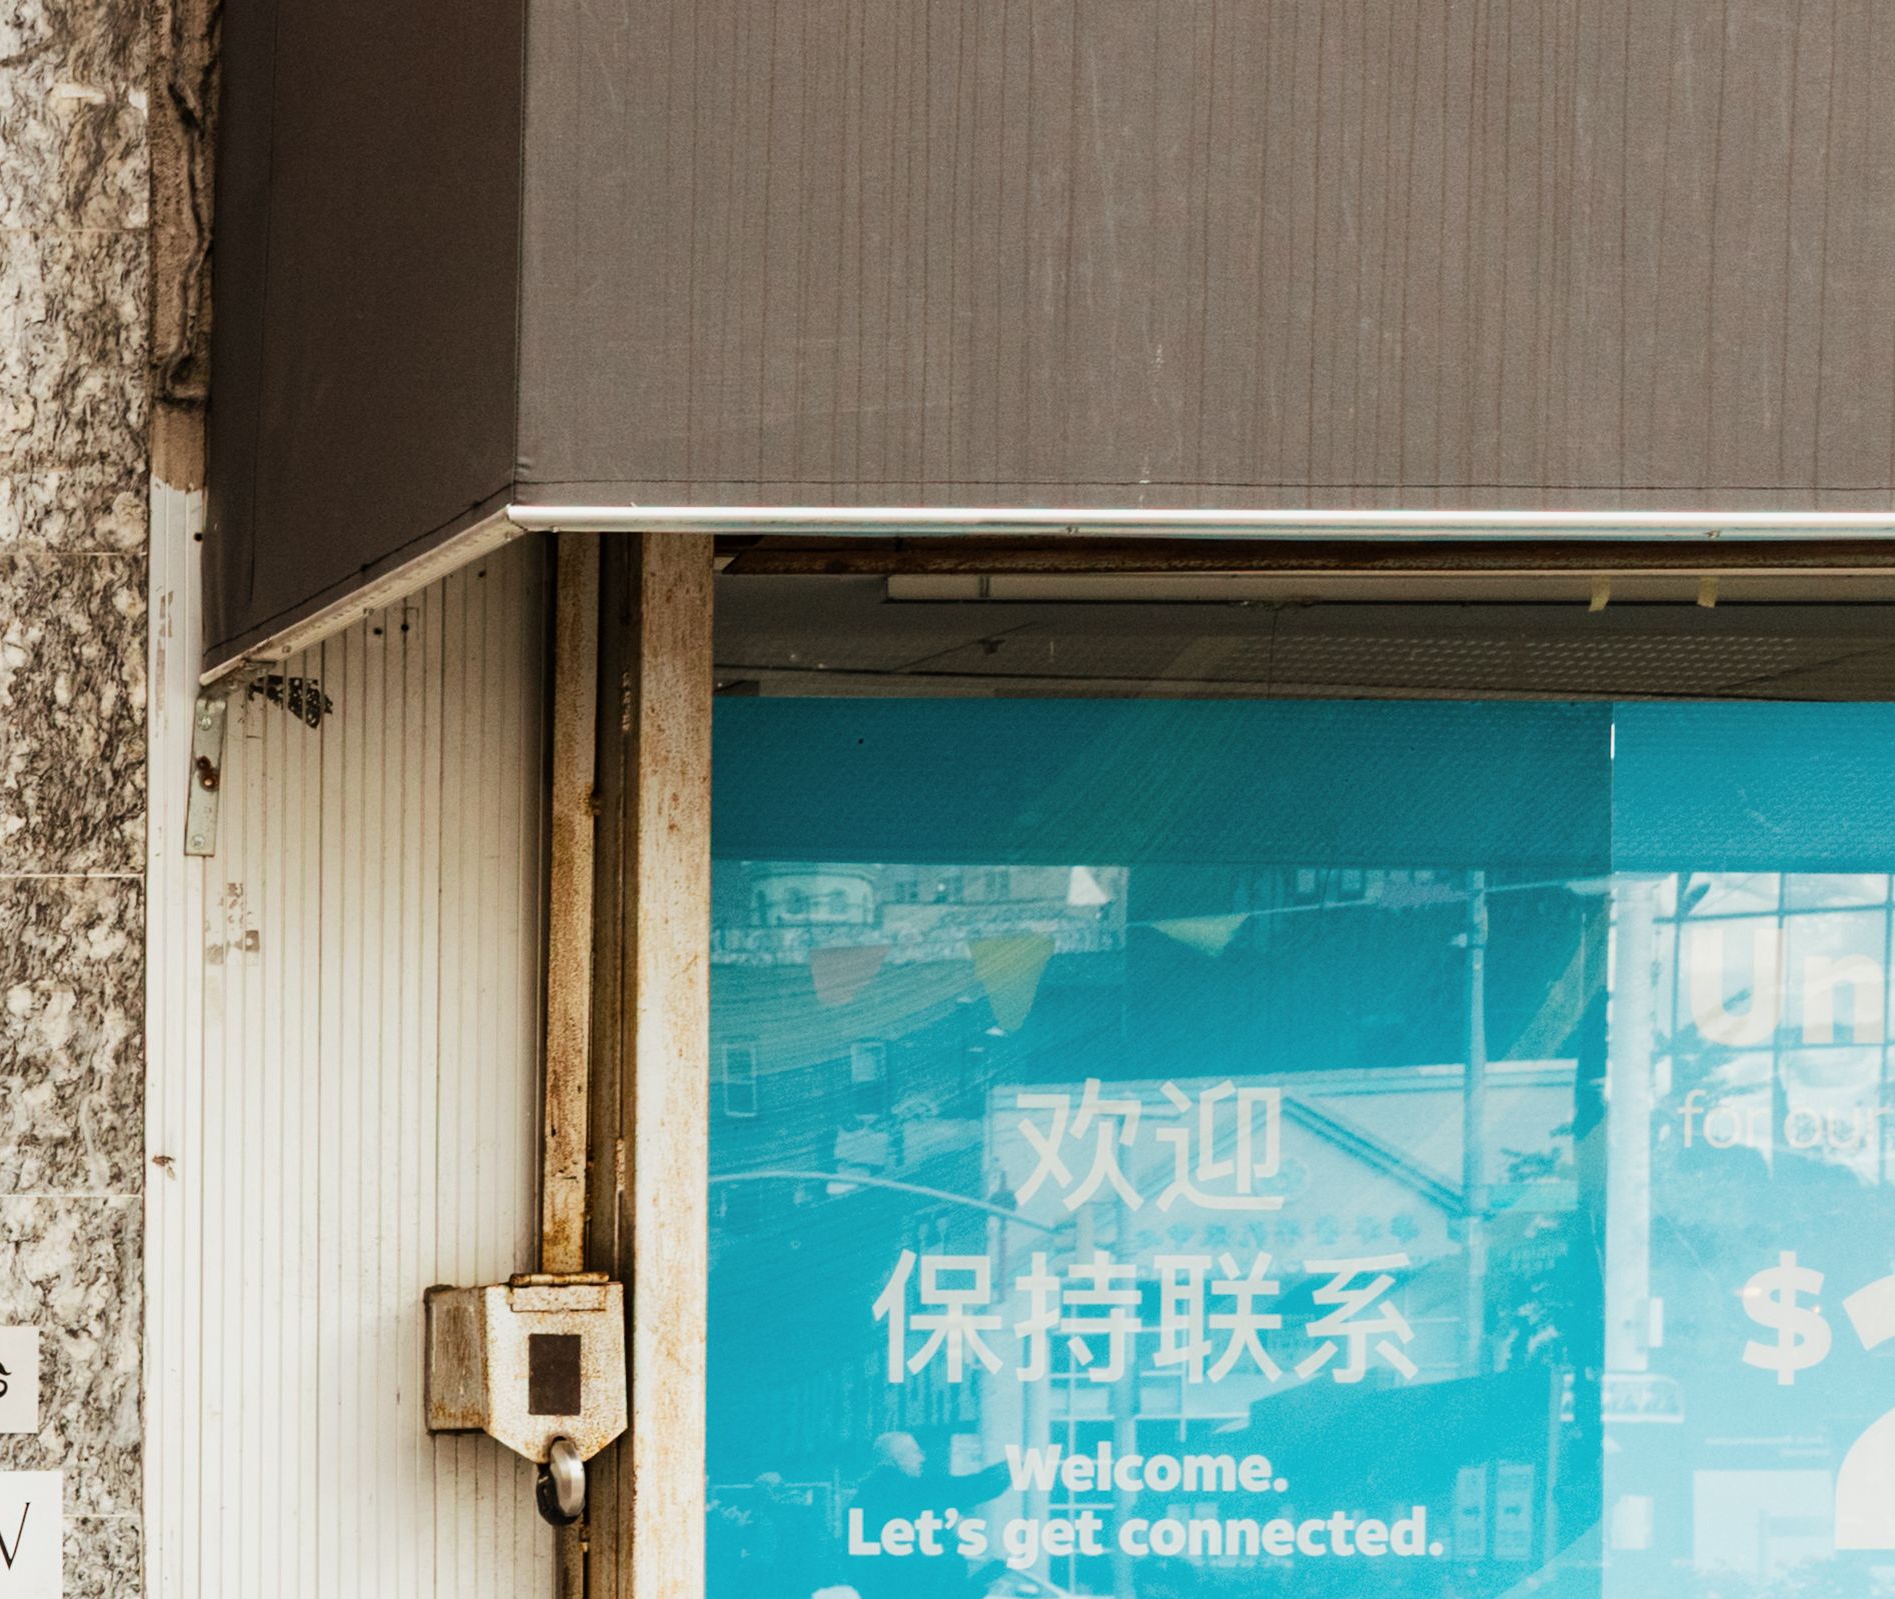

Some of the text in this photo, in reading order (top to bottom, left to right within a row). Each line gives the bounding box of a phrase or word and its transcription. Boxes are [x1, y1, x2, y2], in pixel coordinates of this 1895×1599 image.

[1014, 1077, 1286, 1214] 欢迎
[1676, 1089, 1762, 1149] for
[872, 1249, 1422, 1388] 保持联系
[1005, 1441, 1289, 1492] Welcome.
[848, 1506, 1444, 1569] Let’s get connected.
